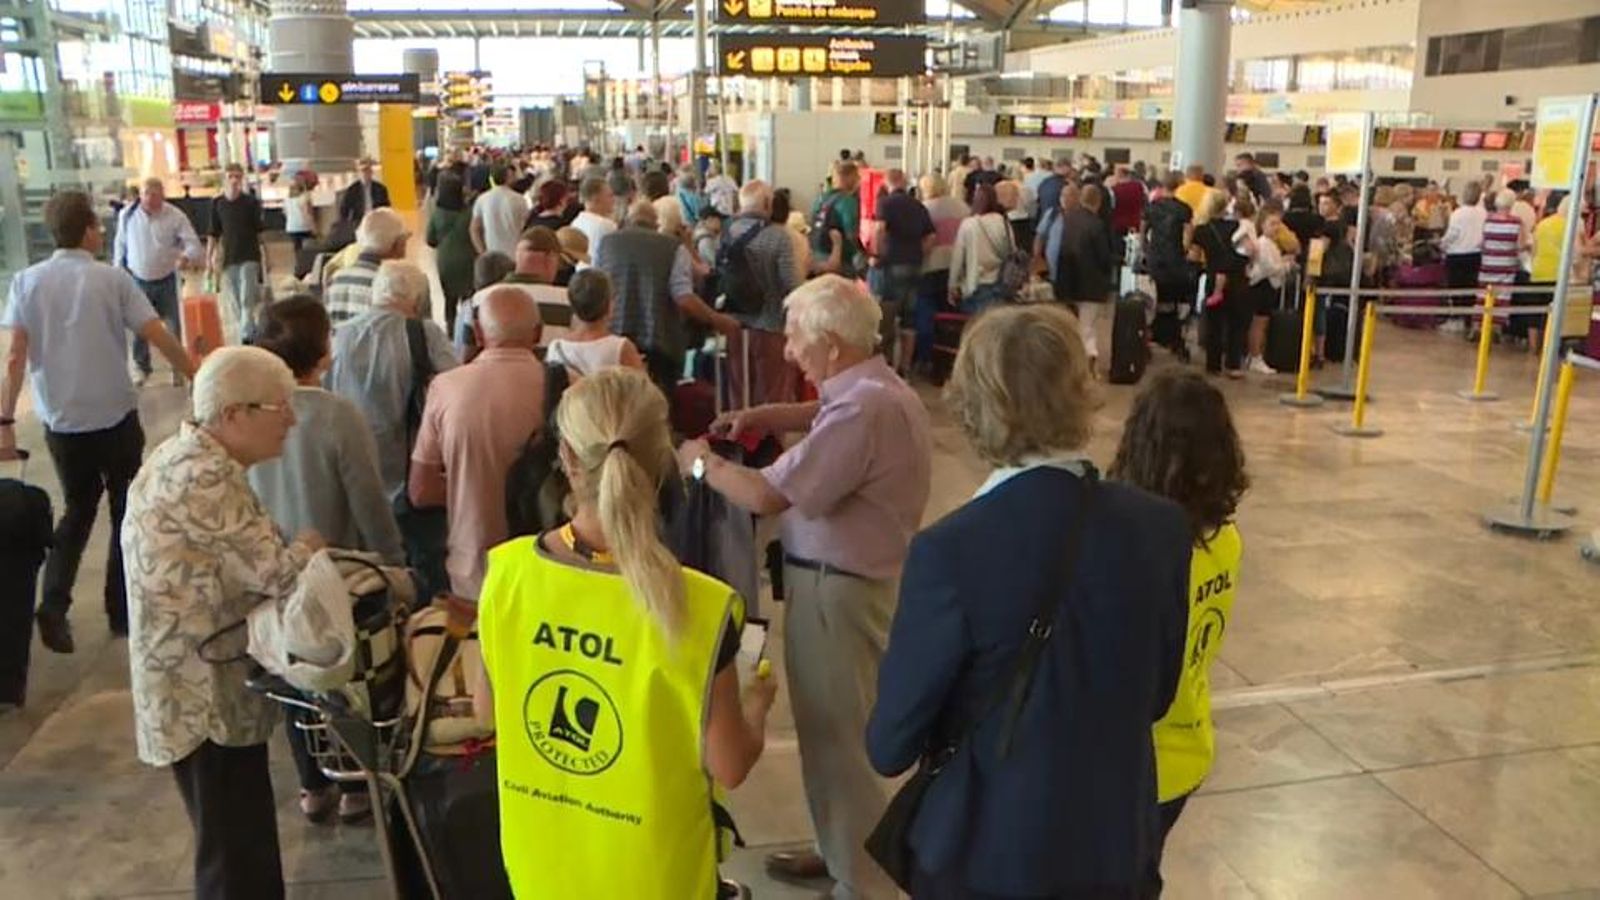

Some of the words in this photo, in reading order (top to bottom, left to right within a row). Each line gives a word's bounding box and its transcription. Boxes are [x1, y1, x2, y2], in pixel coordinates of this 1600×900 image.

[1195, 571, 1232, 603] ATOL
[533, 621, 623, 666] ATOL
[529, 720, 609, 769] PROTECTED
[504, 779, 529, 795] Civil
[531, 788, 583, 807] Aviation
[585, 802, 642, 825] Authority
